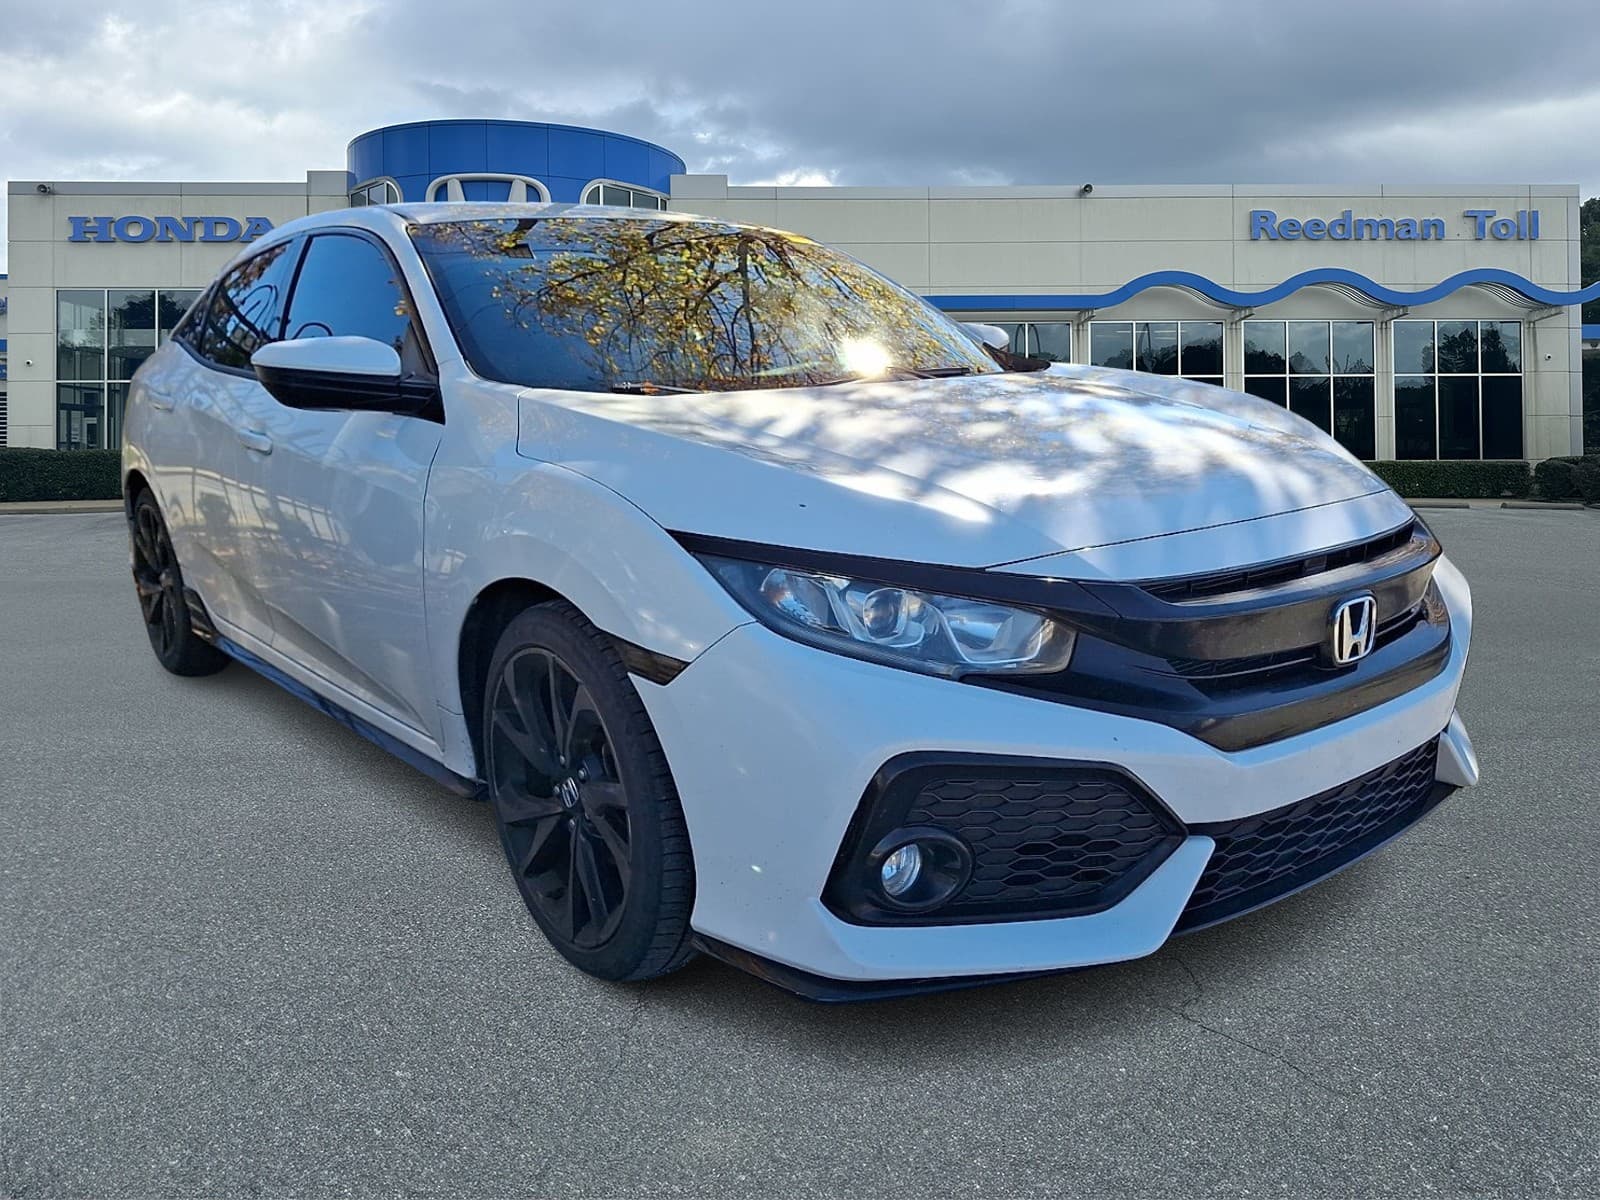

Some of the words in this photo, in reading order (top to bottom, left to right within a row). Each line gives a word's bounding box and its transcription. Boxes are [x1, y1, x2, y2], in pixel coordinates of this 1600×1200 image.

[68, 216, 275, 243] HONDA
[1250, 210, 1445, 241] Reedman
[1464, 210, 1539, 241] Toll
